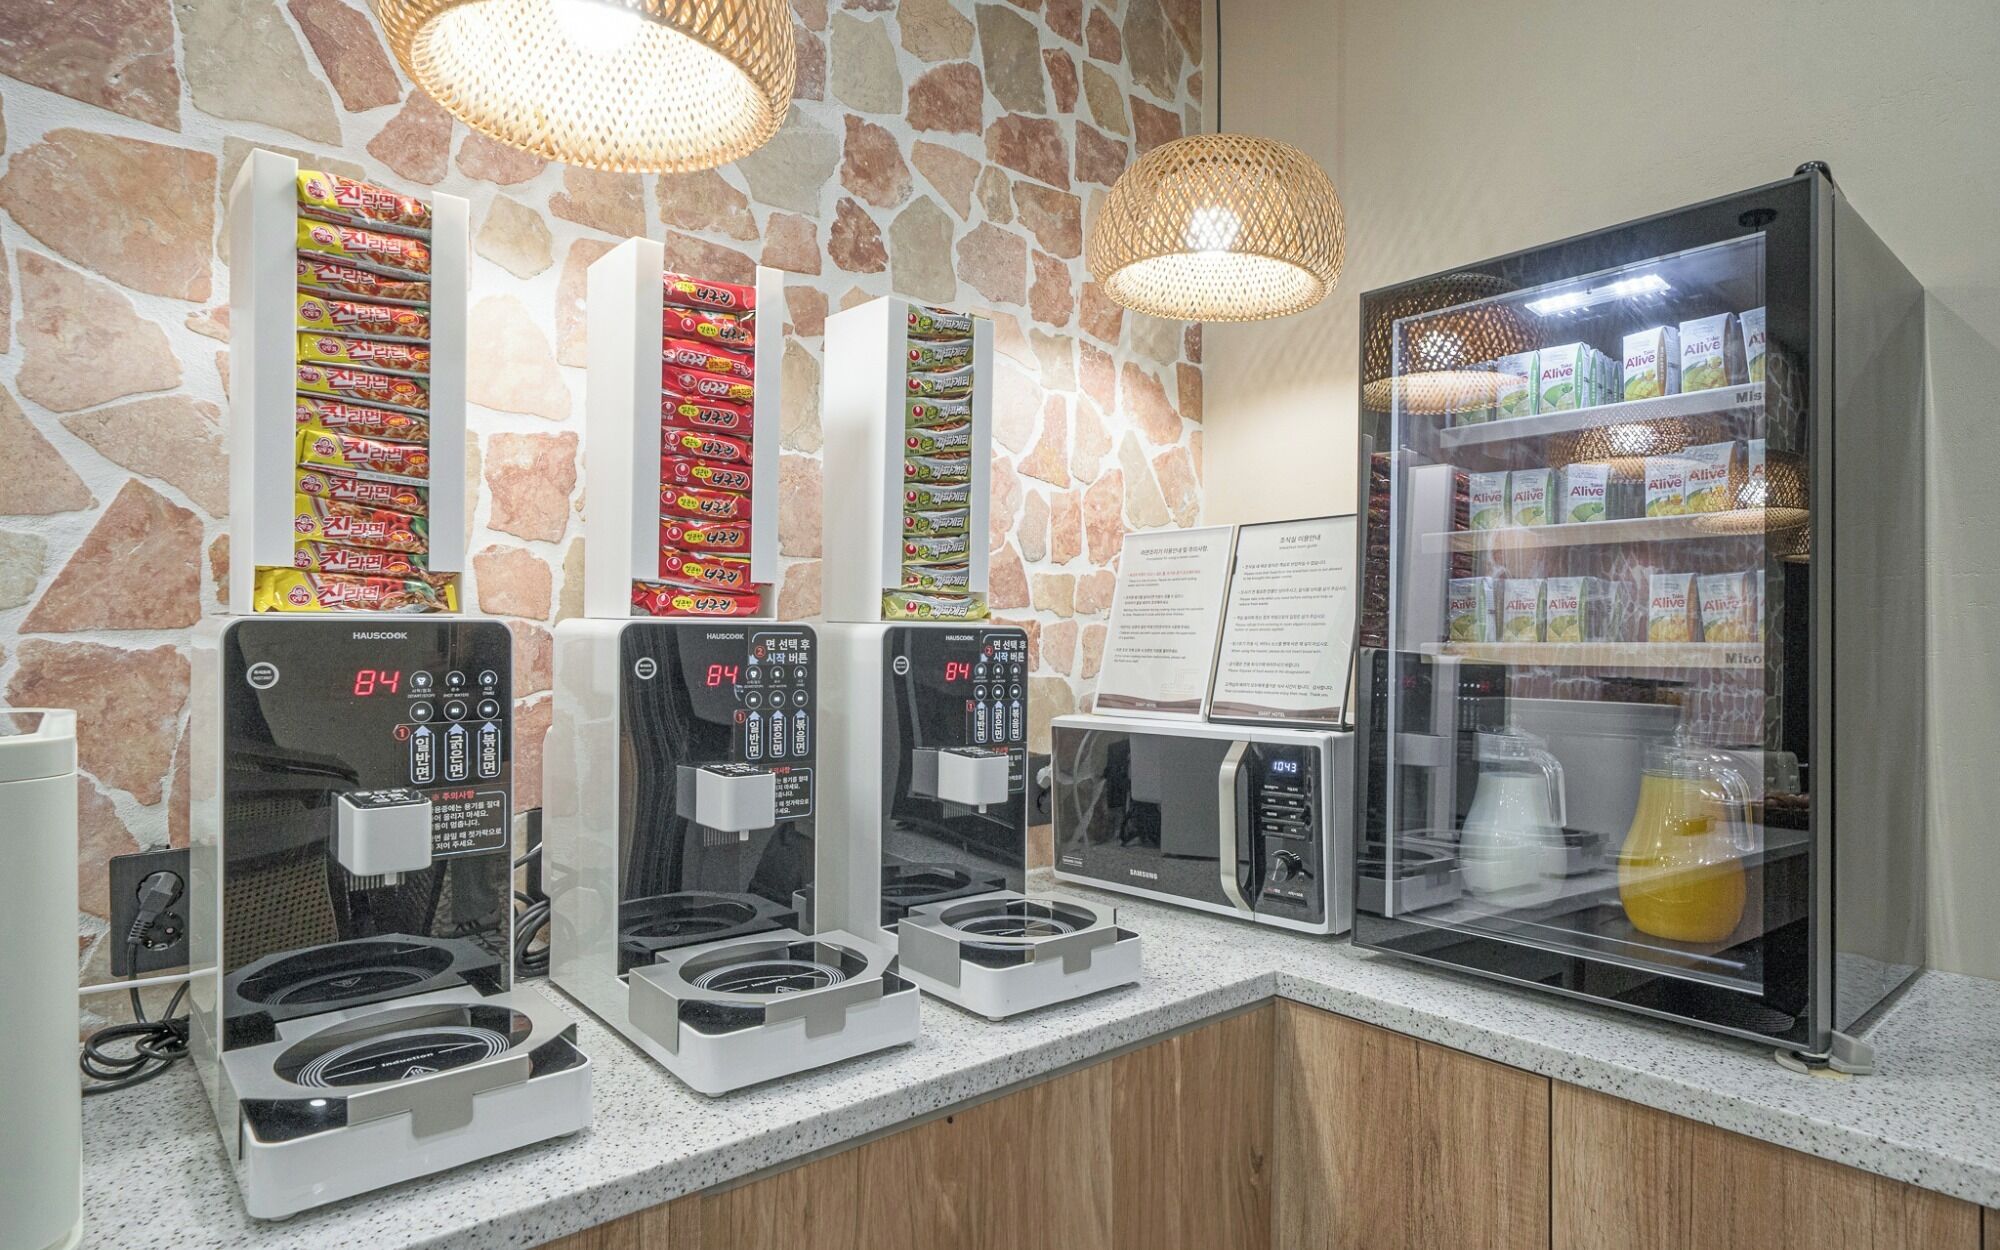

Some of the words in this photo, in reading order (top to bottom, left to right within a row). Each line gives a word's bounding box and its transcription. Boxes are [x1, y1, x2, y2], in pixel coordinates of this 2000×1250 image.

[335, 185, 396, 209] 진라면
[341, 231, 402, 254] 진라면
[697, 288, 730, 304] 너구리
[330, 301, 391, 326] 진라면
[934, 318, 971, 333] 짜파게티
[347, 340, 407, 360] 진라면
[933, 346, 968, 364] 짜파게티
[1684, 341, 1720, 356] Alive
[1625, 354, 1656, 370] Alive
[327, 368, 389, 390] 진라면
[1542, 367, 1574, 380] Alive
[934, 376, 970, 392] 짜파게티
[1736, 392, 1762, 404] Mis
[320, 404, 382, 428] 진라면
[700, 410, 734, 424] 너구리
[702, 440, 735, 454] 너구리
[935, 434, 968, 450] 짜파게티
[342, 440, 402, 463] 진라면
[712, 472, 746, 487] 너구리
[1690, 468, 1726, 481] Alive
[330, 478, 392, 499] 진라면
[1570, 486, 1604, 496] Alive
[1648, 478, 1682, 490] Alive
[1472, 494, 1502, 503] Alive
[1514, 490, 1544, 502] Alive
[322, 516, 386, 538] 진라면
[706, 531, 740, 544] 너구리
[318, 550, 382, 572] 진라면
[704, 568, 738, 583] 너구리
[934, 576, 968, 590] 짜파게티
[316, 582, 380, 607] 진라면
[696, 598, 731, 612] 너구리
[1505, 600, 1536, 611] Alive
[1548, 599, 1578, 610] Alive
[1652, 597, 1686, 609] Alive
[930, 604, 968, 618] 짜파게티
[352, 632, 408, 640] HAUSCOOK
[766, 639, 776, 650] 면
[778, 639, 798, 650] 선택
[800, 639, 810, 650] 후
[994, 640, 1001, 650] 면
[1002, 640, 1018, 650] 선택
[1018, 640, 1026, 650] 후
[766, 652, 786, 664] 시작
[788, 653, 808, 664] 버튼
[994, 652, 1008, 662] 시작
[1010, 652, 1024, 662] 버튼
[1724, 652, 1764, 664] Miso
[706, 664, 738, 686] 84
[946, 662, 970, 680] 84
[354, 670, 400, 696] 84
[750, 721, 760, 757] 일반면
[416, 738, 430, 780] 일반면
[449, 735, 464, 778] 굵은면
[482, 734, 496, 775] 볶음면
[442, 790, 475, 800] 주의사항
[432, 804, 462, 814] 용중에는
[464, 802, 485, 810] 용기를
[486, 800, 500, 809] 절대
[466, 810, 488, 819] 마세요.
[432, 822, 448, 831] 동이
[452, 840, 476, 848] 주세요.
[1130, 868, 1158, 880] SAMSUNG
[750, 976, 788, 988] Induction
[381, 1052, 434, 1068] Induction
